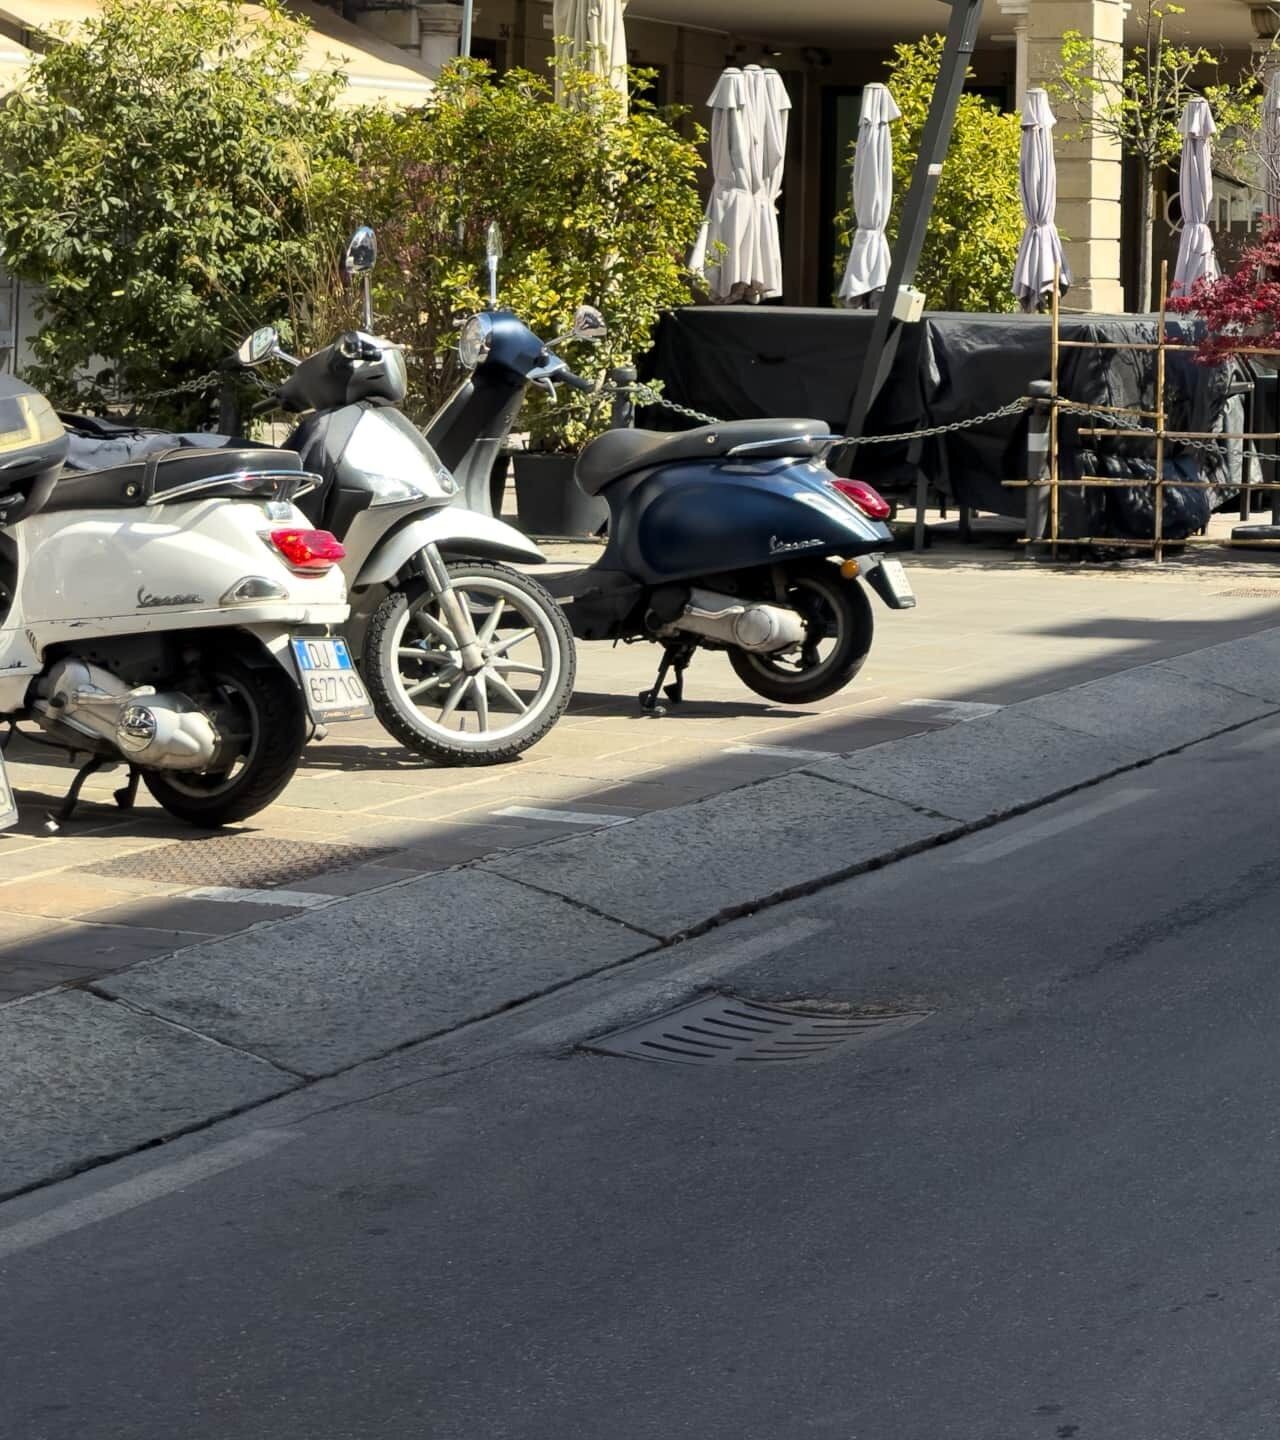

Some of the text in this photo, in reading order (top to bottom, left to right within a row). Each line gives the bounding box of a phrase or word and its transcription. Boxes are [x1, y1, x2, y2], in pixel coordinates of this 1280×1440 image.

[769, 535, 826, 555] Vespa
[136, 585, 204, 608] Vespa
[308, 642, 330, 668] DJ
[310, 675, 364, 703] 62710
